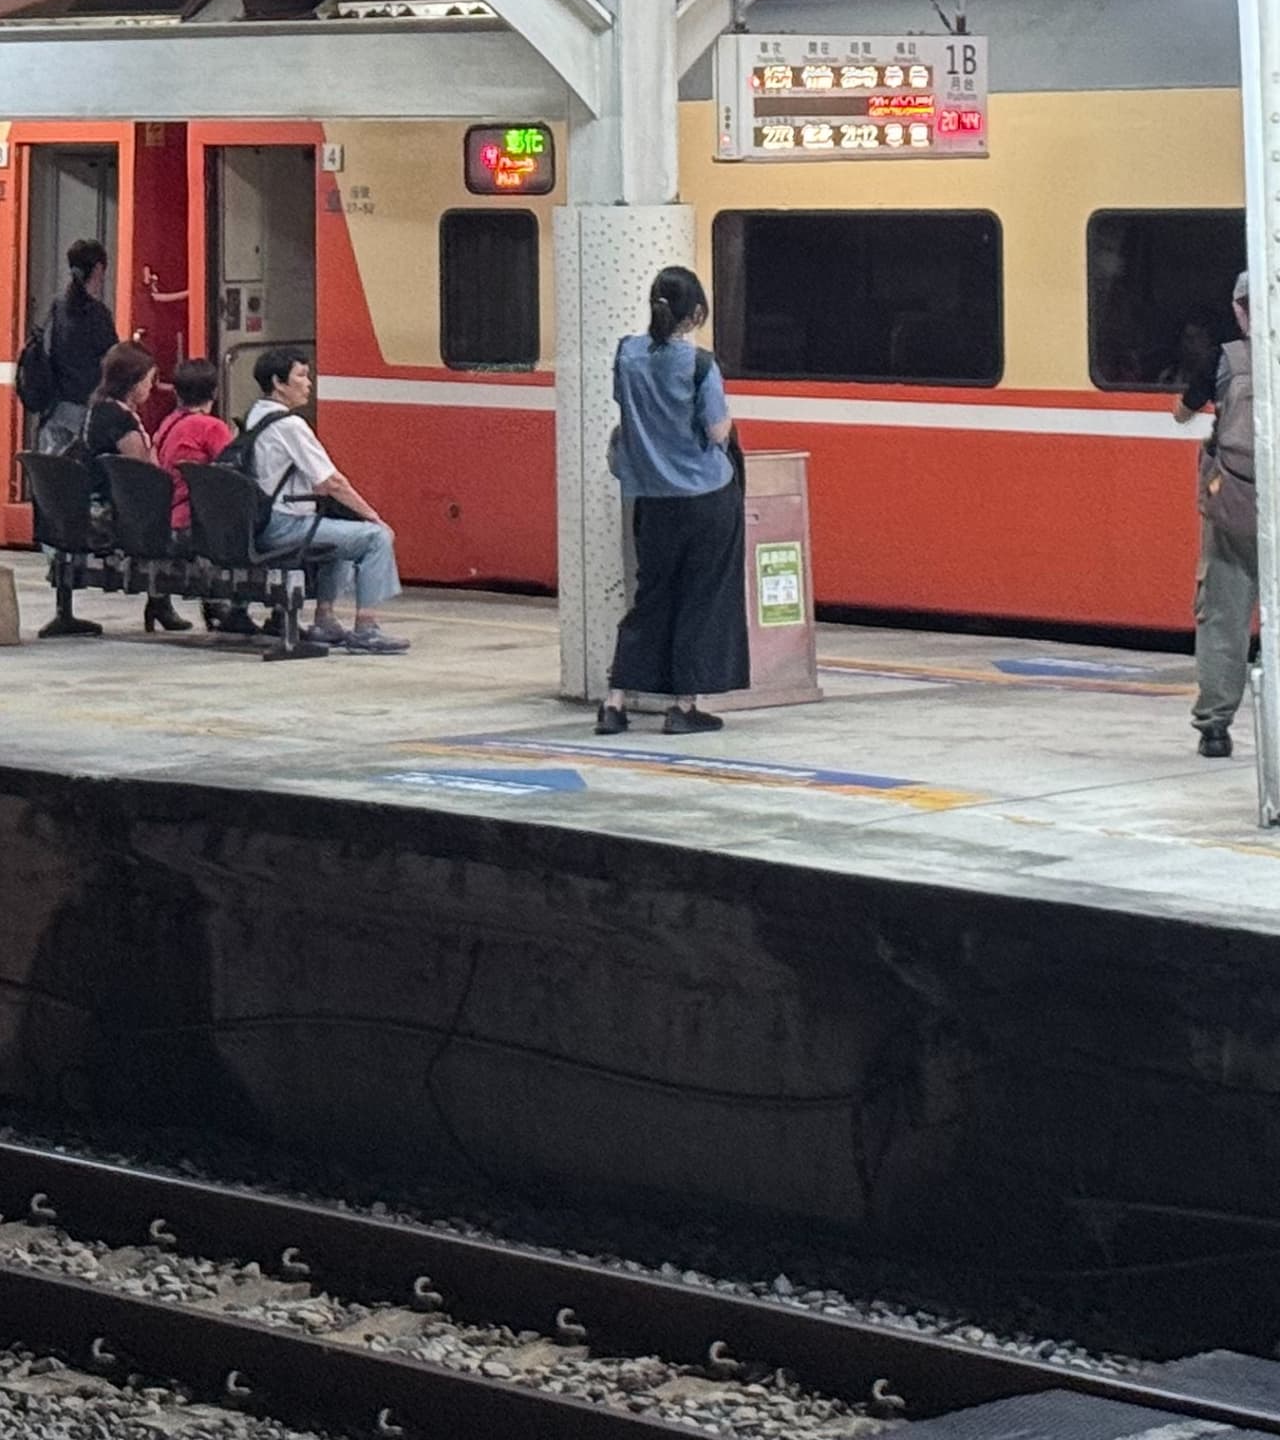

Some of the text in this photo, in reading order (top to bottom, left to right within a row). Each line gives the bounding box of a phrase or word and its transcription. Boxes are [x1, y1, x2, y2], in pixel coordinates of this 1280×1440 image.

[946, 44, 978, 75] 1B
[950, 76, 975, 91] 月台
[327, 147, 337, 165] 4
